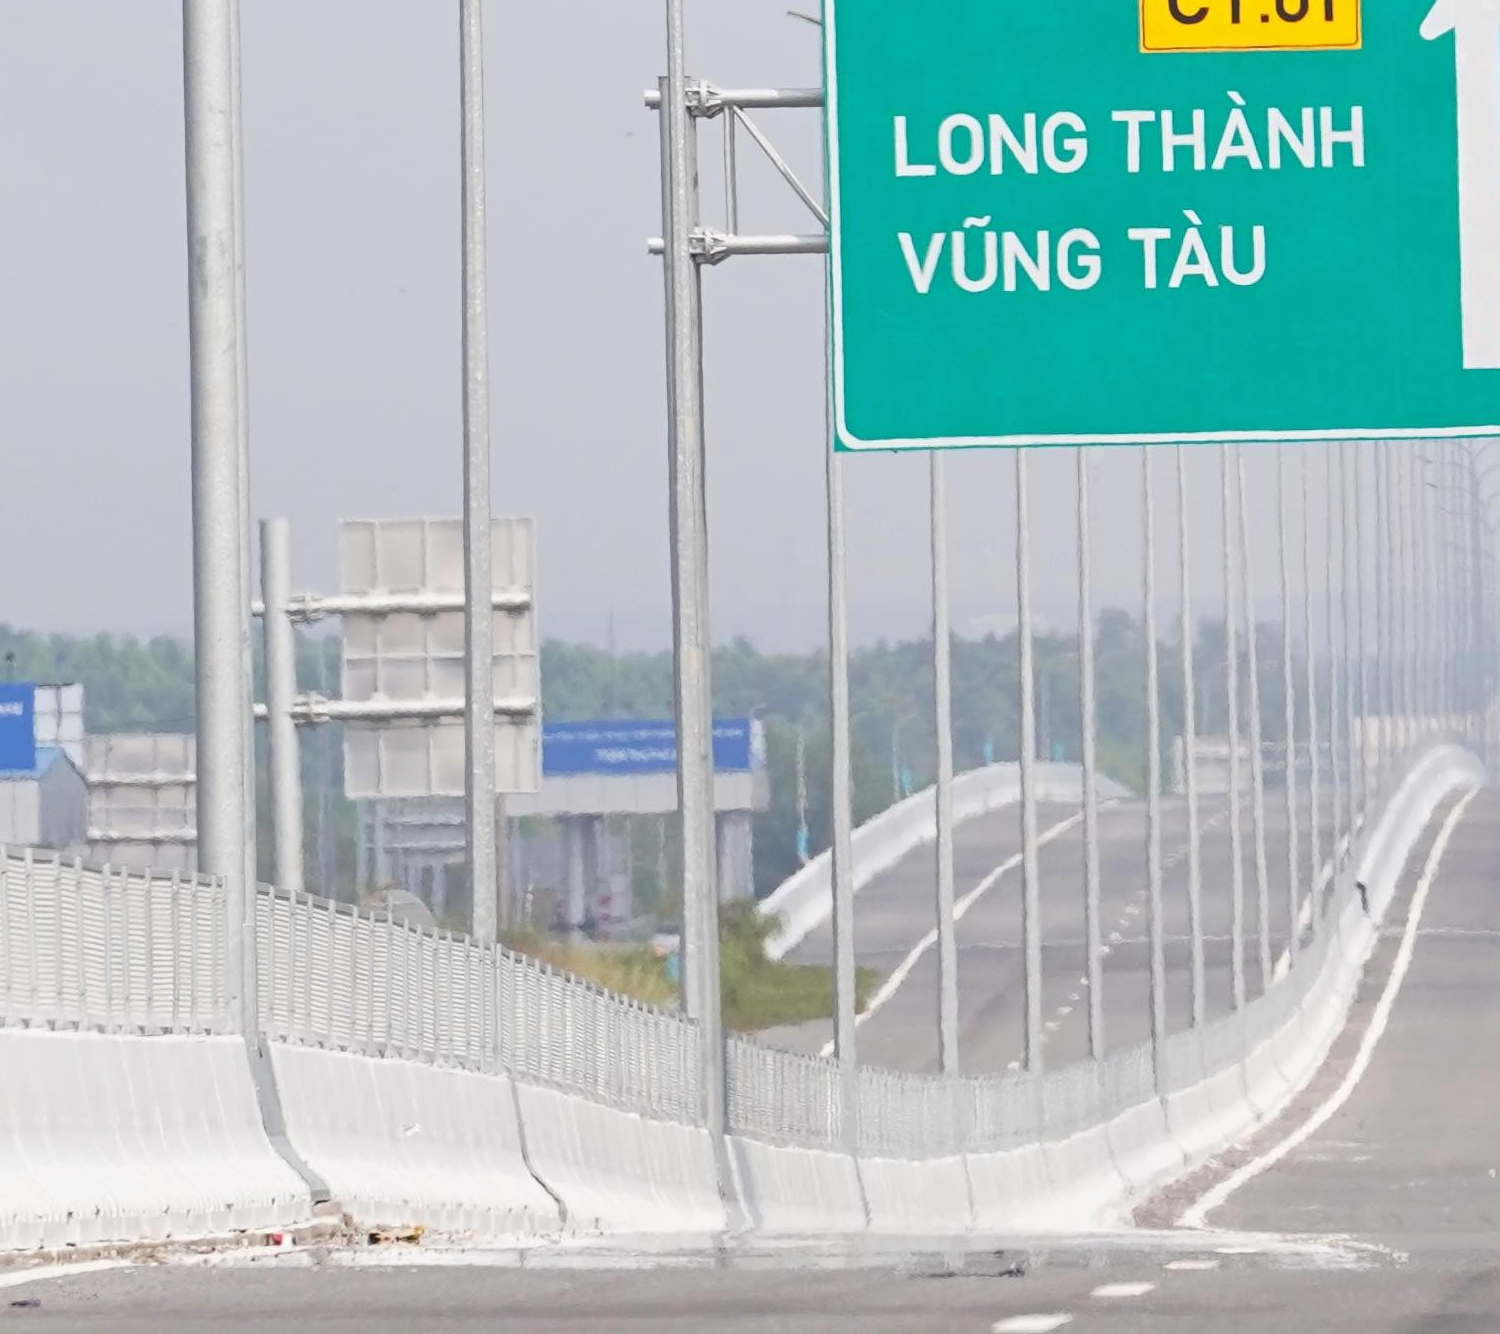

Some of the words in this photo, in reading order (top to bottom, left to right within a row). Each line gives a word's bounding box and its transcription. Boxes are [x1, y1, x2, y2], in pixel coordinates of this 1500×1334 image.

[895, 111, 1088, 178] LONG
[1111, 91, 1366, 174] THÀNH
[898, 215, 1101, 294] VŨNG
[1128, 209, 1267, 288] TÀU
